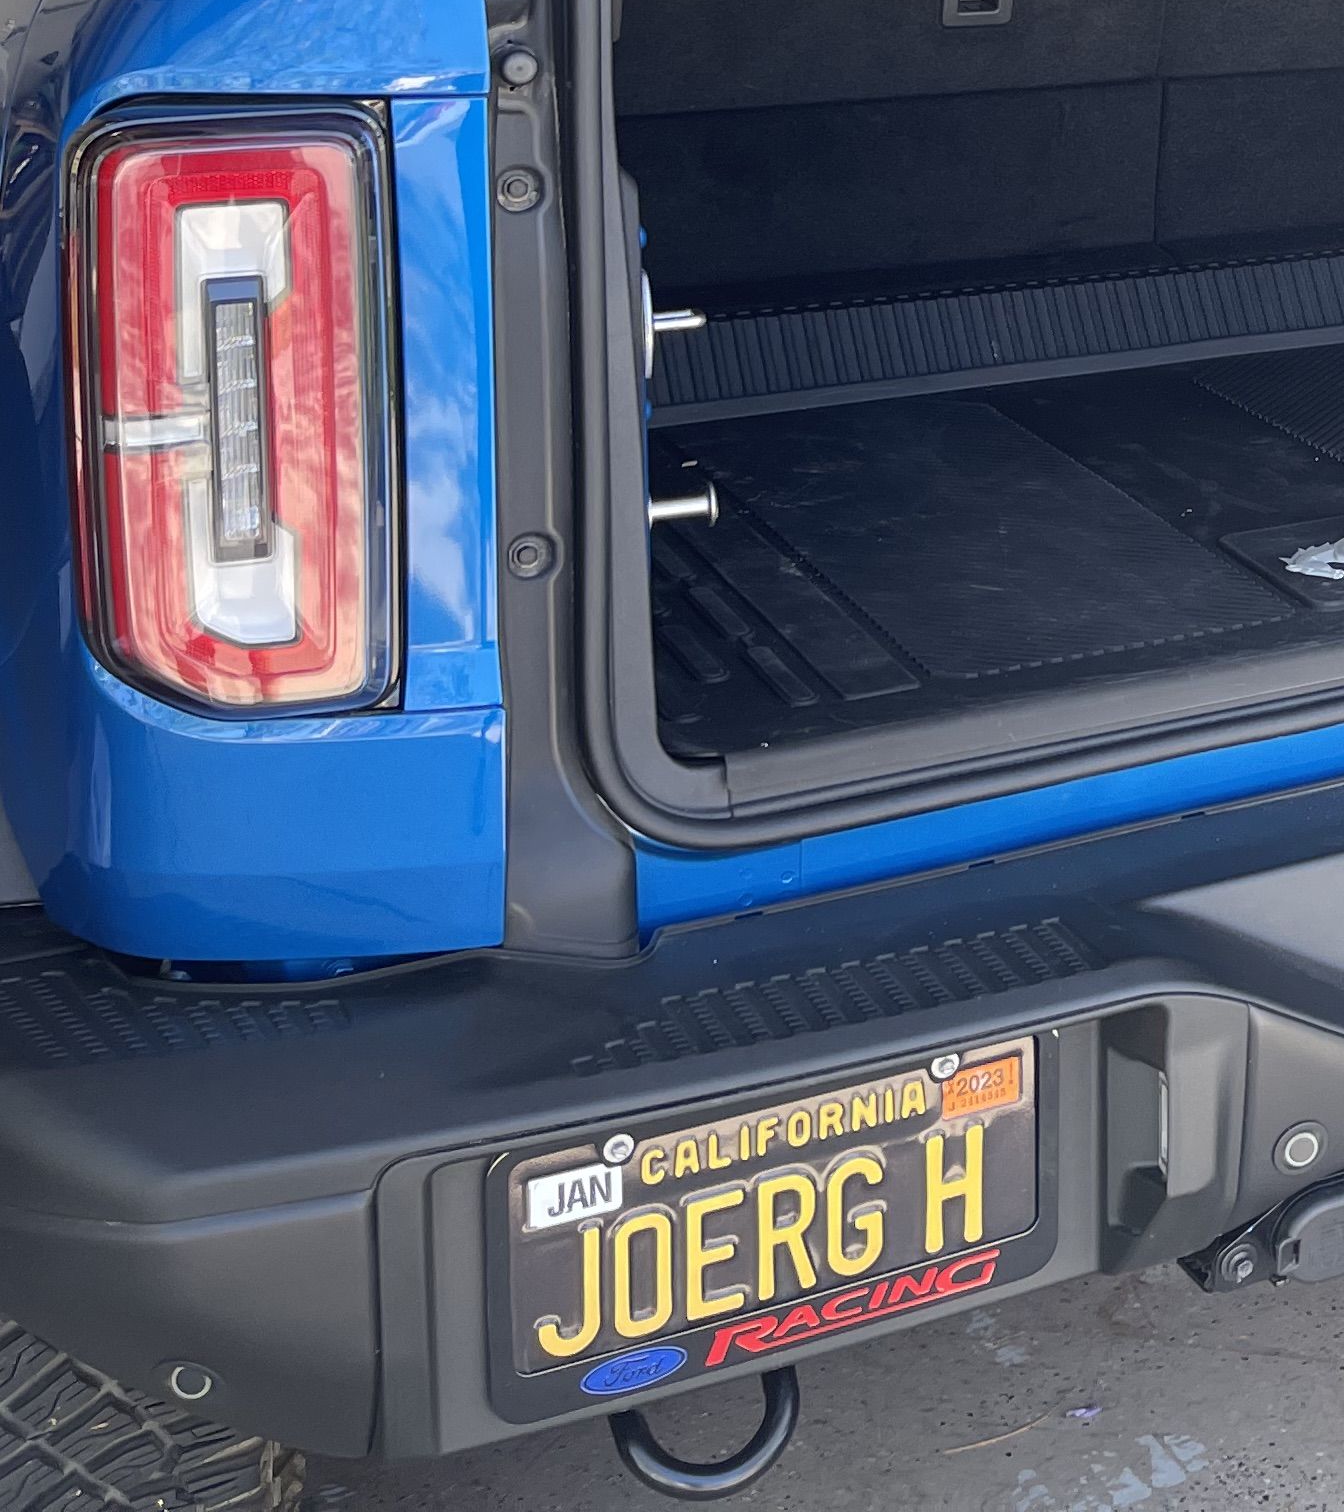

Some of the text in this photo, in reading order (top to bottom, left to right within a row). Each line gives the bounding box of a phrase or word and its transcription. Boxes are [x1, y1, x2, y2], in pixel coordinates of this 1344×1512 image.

[640, 1081, 927, 1186] CALIFORNIA
[956, 1068, 1005, 1098] 2023
[537, 1124, 985, 1359] JOERG H
[546, 1170, 614, 1220] JAN
[602, 1249, 1001, 1389] Ford RACING
